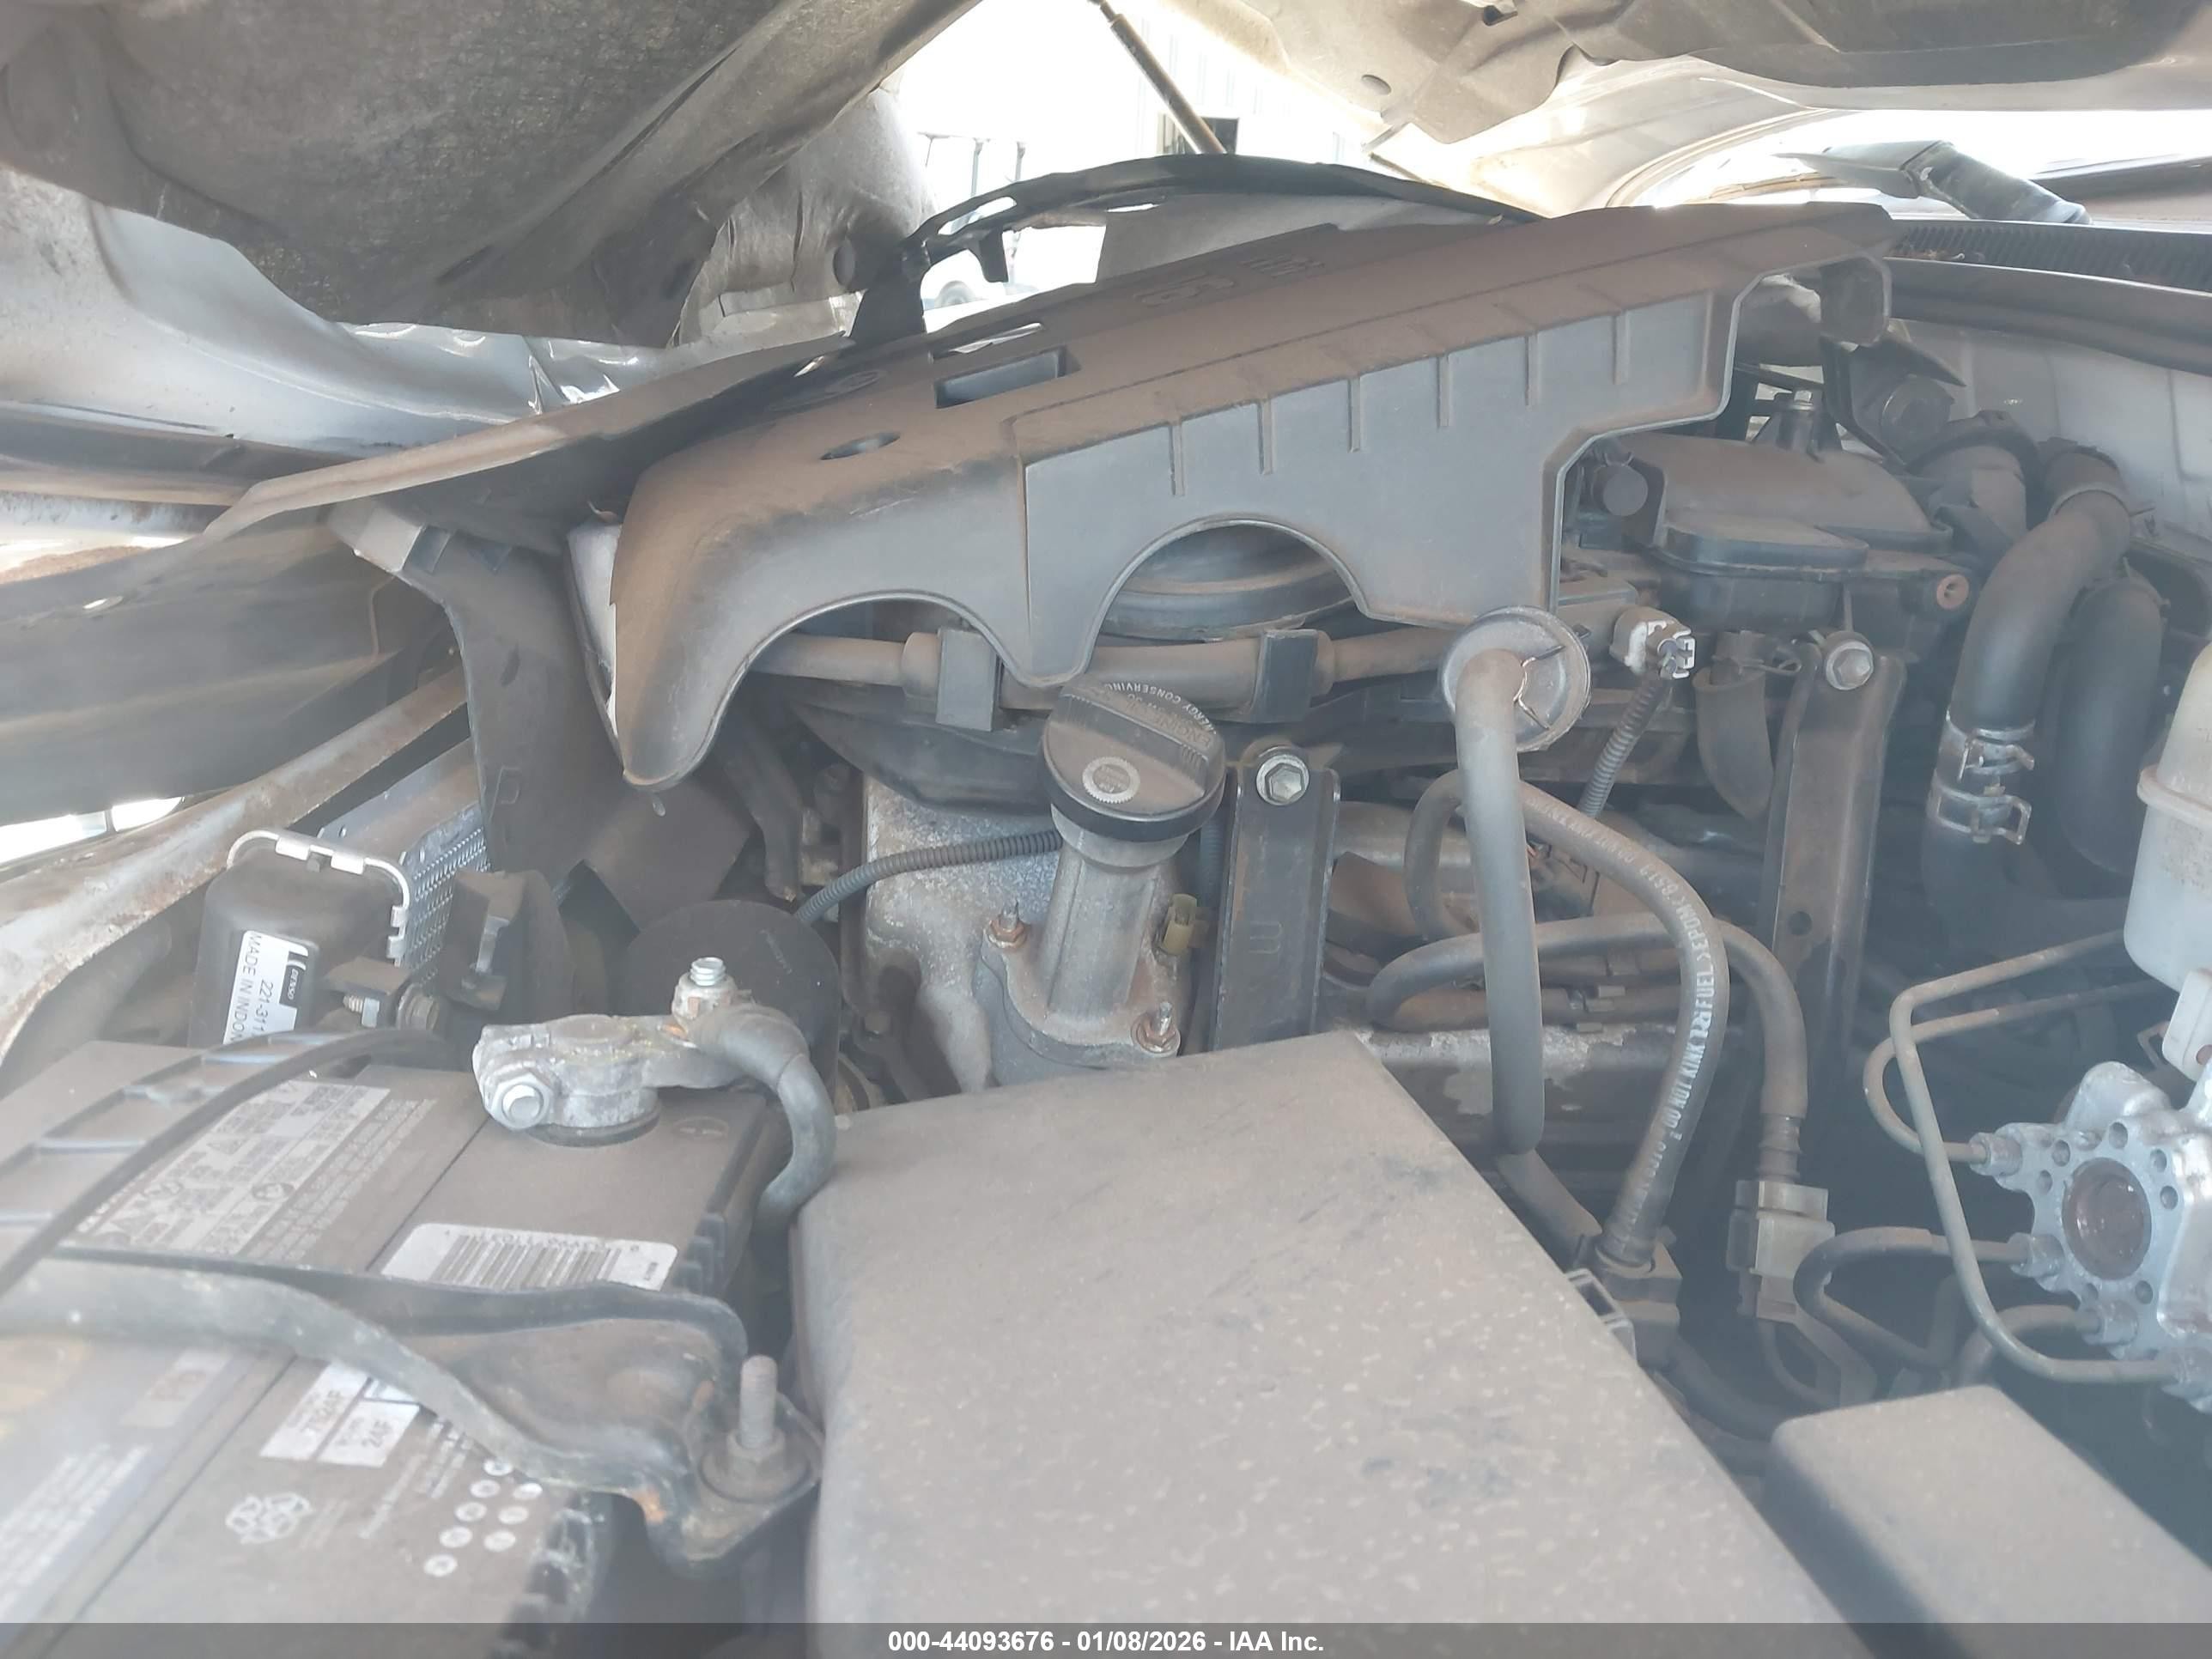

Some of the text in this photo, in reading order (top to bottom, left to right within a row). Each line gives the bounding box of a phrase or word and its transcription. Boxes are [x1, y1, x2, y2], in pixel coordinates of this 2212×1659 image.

[1182, 702, 1217, 734] NERGY
[242, 933, 263, 976] MADE
[240, 977, 255, 994] IN
[1695, 963, 1715, 1009] FUEL
